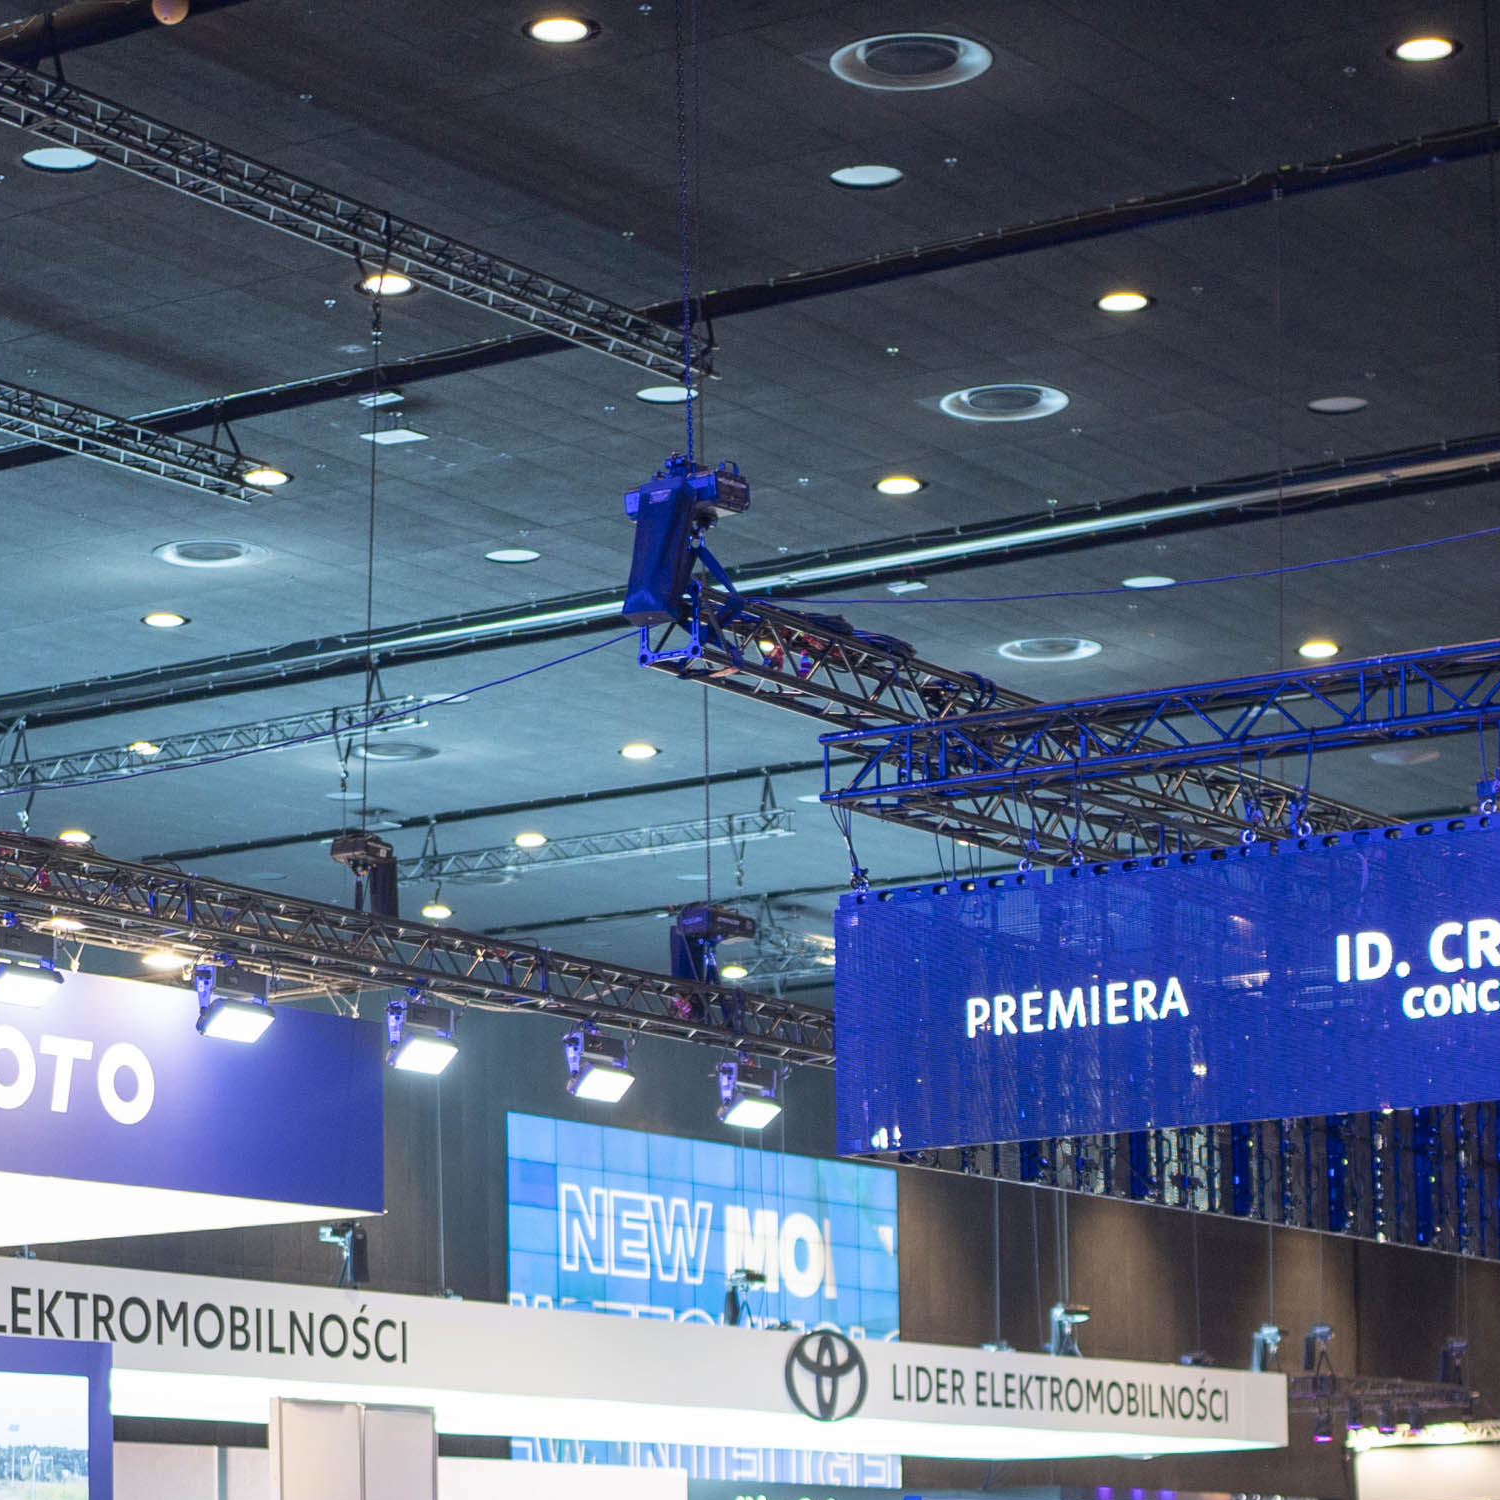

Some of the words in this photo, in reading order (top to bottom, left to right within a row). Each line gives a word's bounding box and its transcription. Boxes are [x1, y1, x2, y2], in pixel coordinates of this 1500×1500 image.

[1336, 931, 1410, 982] ID.
[965, 976, 1190, 1038] PREMIERA
[559, 1183, 713, 1285] NEW
[892, 1363, 966, 1406] LIDER
[975, 1371, 1230, 1424] ELEKTROMOBILNOŚCI
